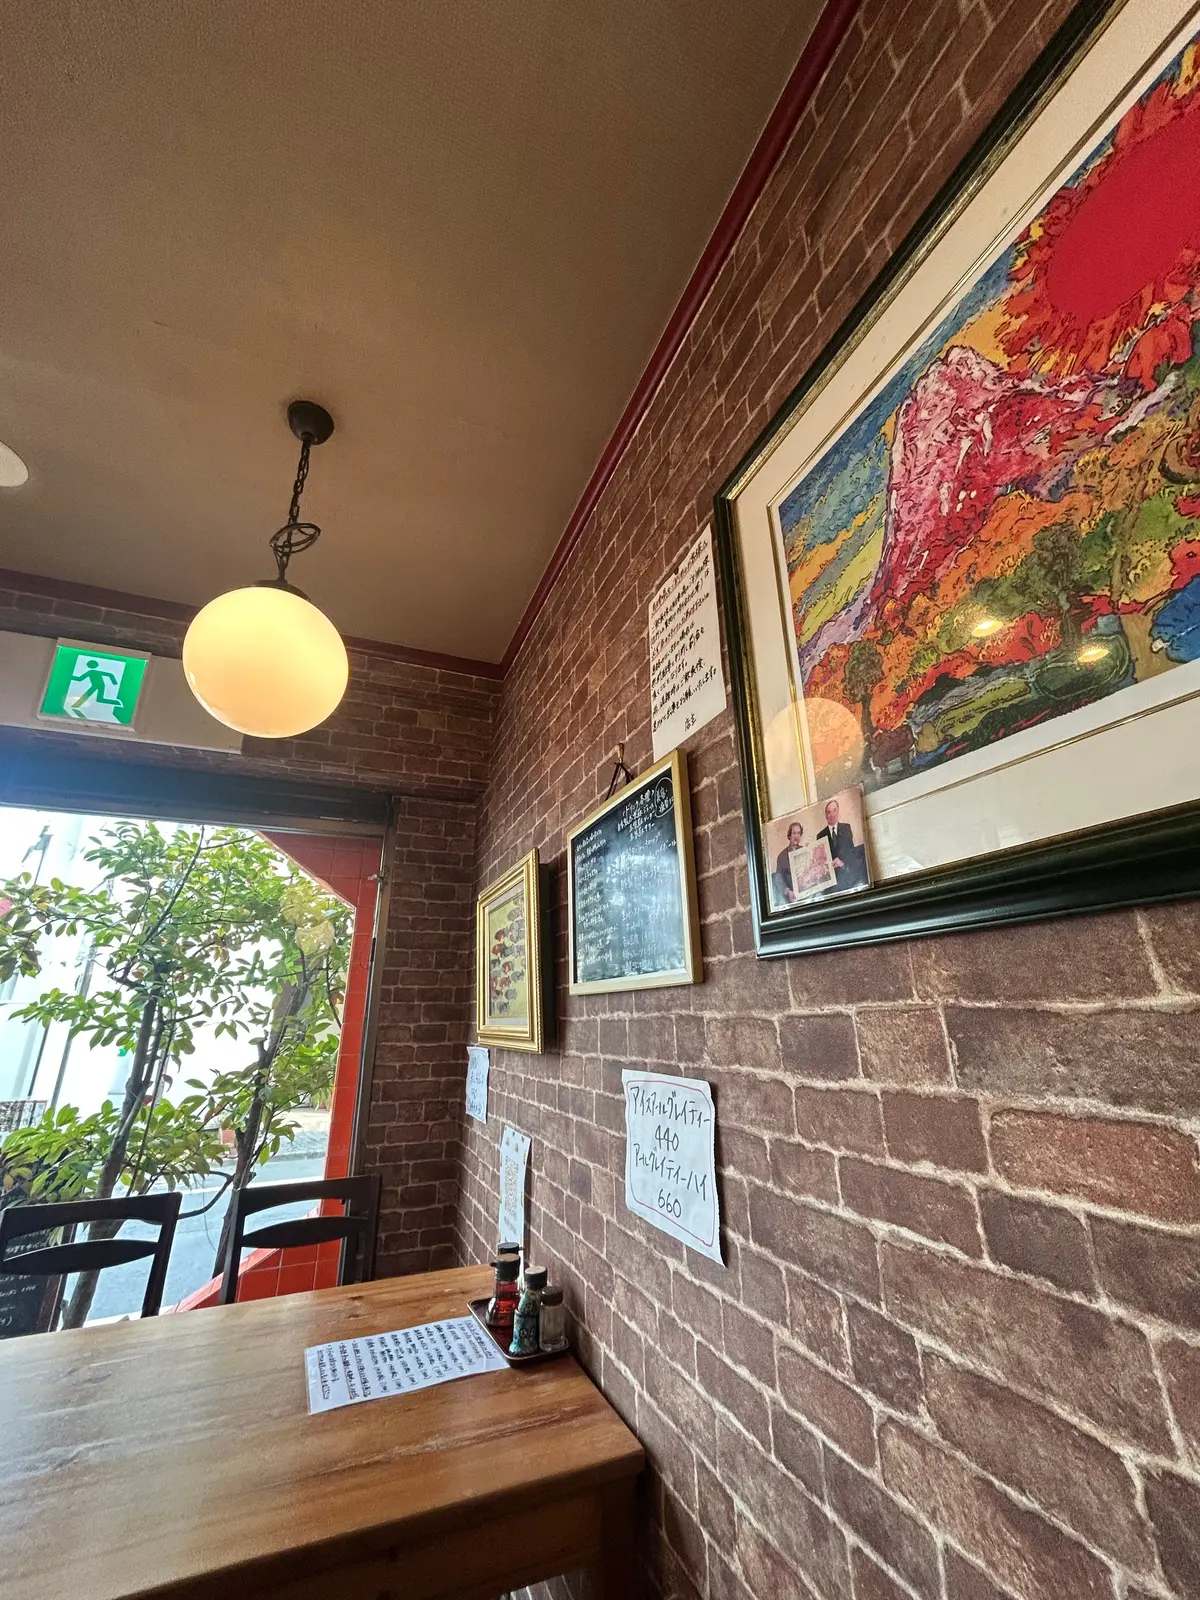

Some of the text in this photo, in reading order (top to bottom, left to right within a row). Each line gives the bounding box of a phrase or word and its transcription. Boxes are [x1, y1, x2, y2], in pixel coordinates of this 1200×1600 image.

[630, 1086, 710, 1128] アイスアールグレイティー
[655, 1124, 679, 1151] 440
[634, 1143, 707, 1201] アールグレイティーハイ
[658, 1189, 681, 1218] 660
